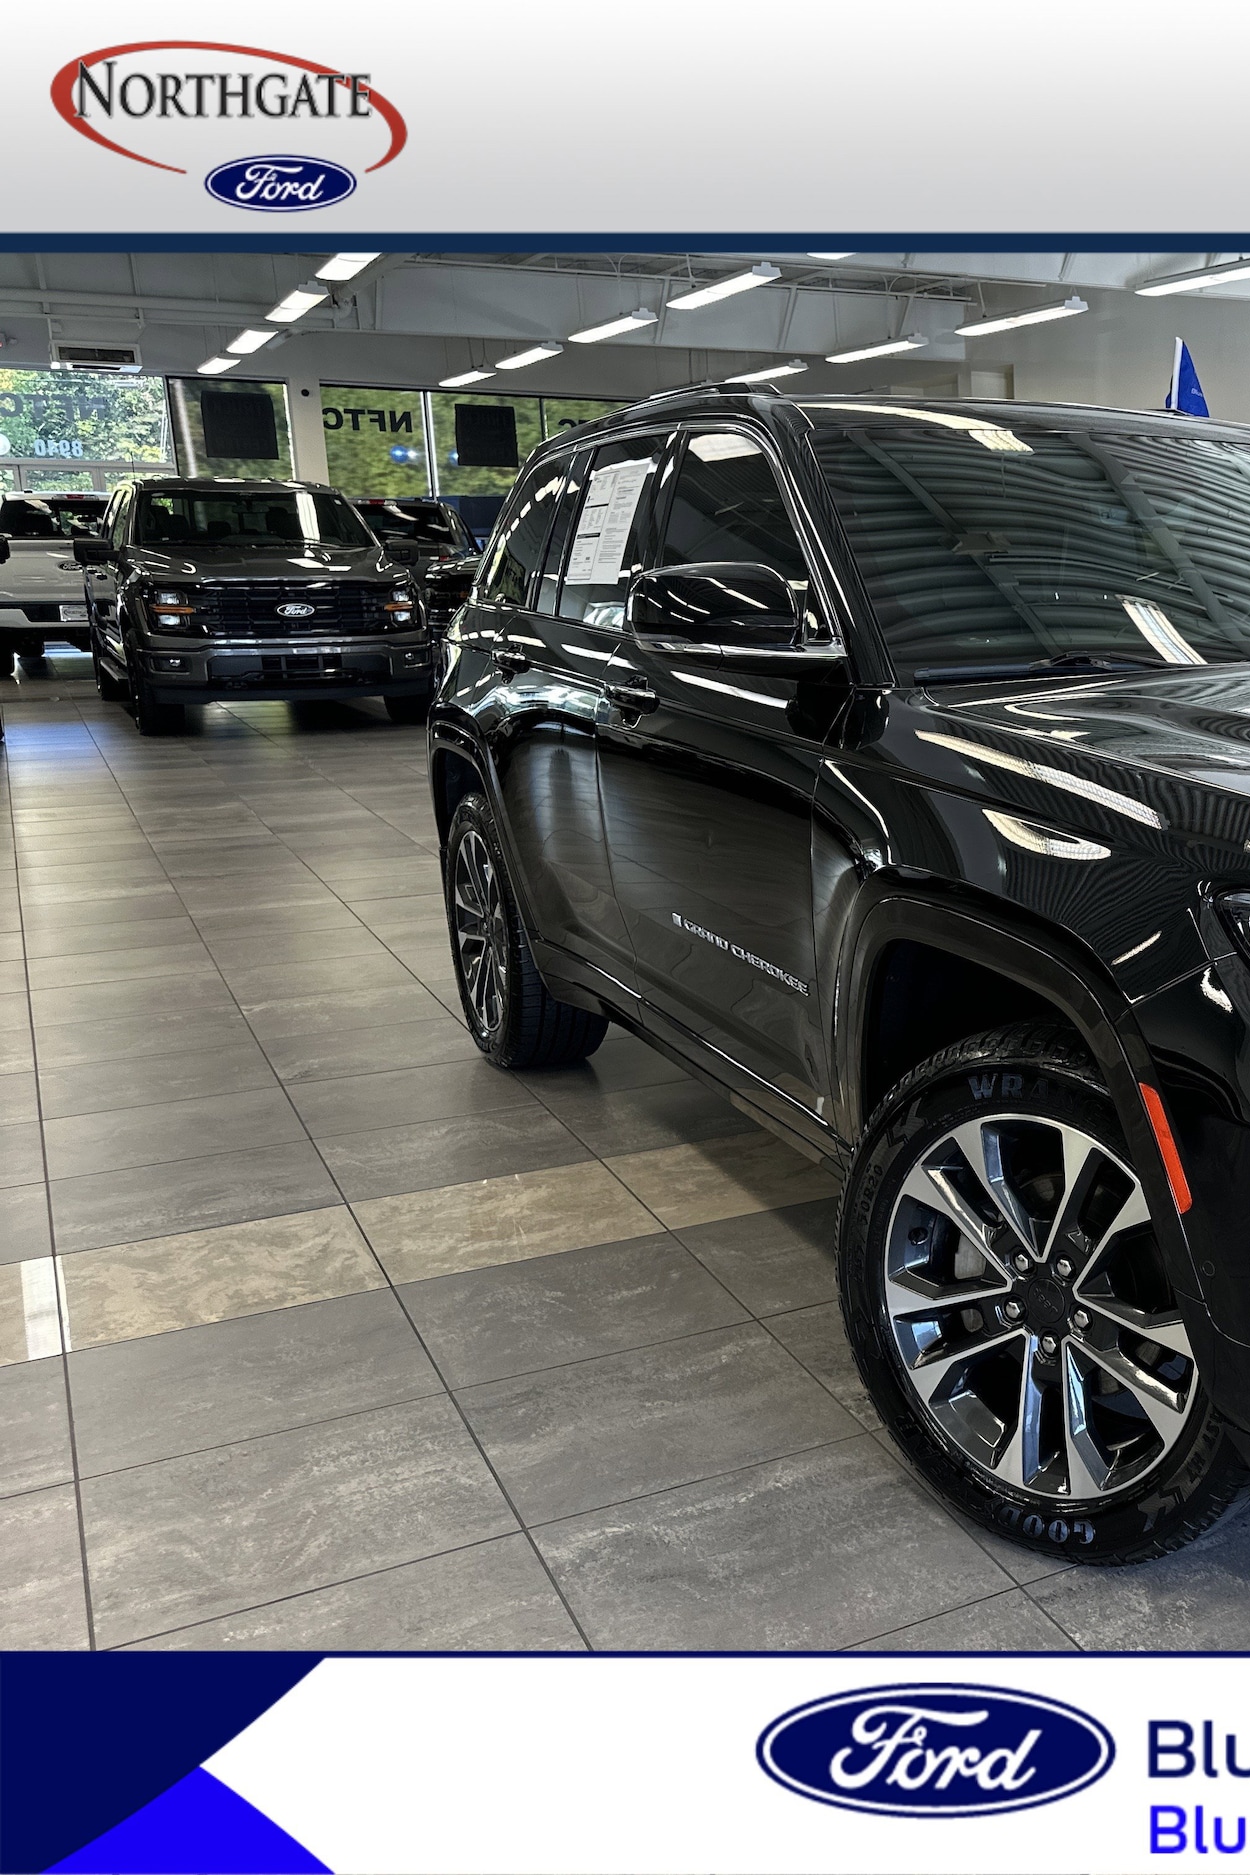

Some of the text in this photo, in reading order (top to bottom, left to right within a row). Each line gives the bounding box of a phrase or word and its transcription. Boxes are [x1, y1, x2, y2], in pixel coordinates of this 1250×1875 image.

[283, 605, 308, 616] Ford
[683, 918, 809, 997] GRAND CHEROKEE
